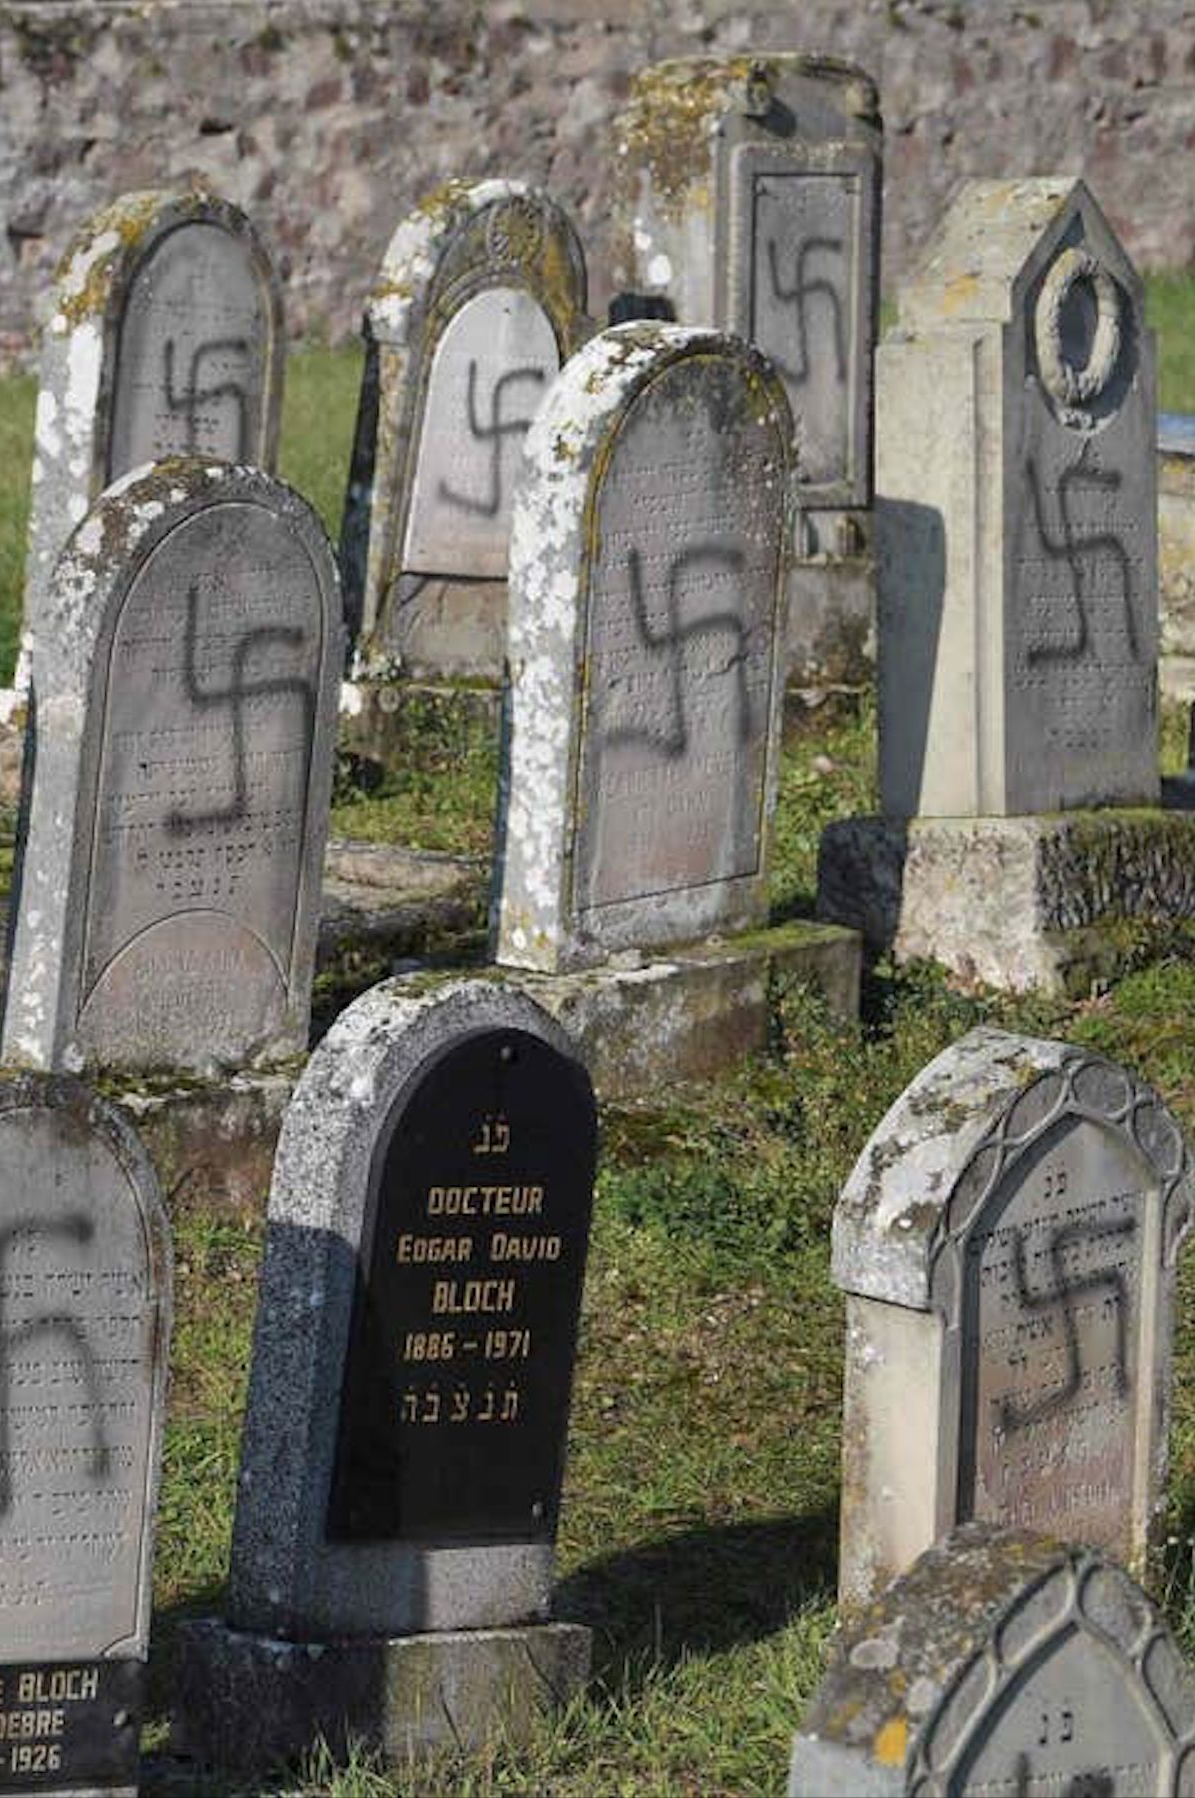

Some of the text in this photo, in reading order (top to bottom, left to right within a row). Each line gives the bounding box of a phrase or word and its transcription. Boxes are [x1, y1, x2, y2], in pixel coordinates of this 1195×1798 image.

[428, 1186, 544, 1214] DOCTEUR
[397, 1233, 561, 1263] EDGAR DAVID
[433, 1279, 516, 1313] BLOCH
[19, 1669, 99, 1702] BLOCH
